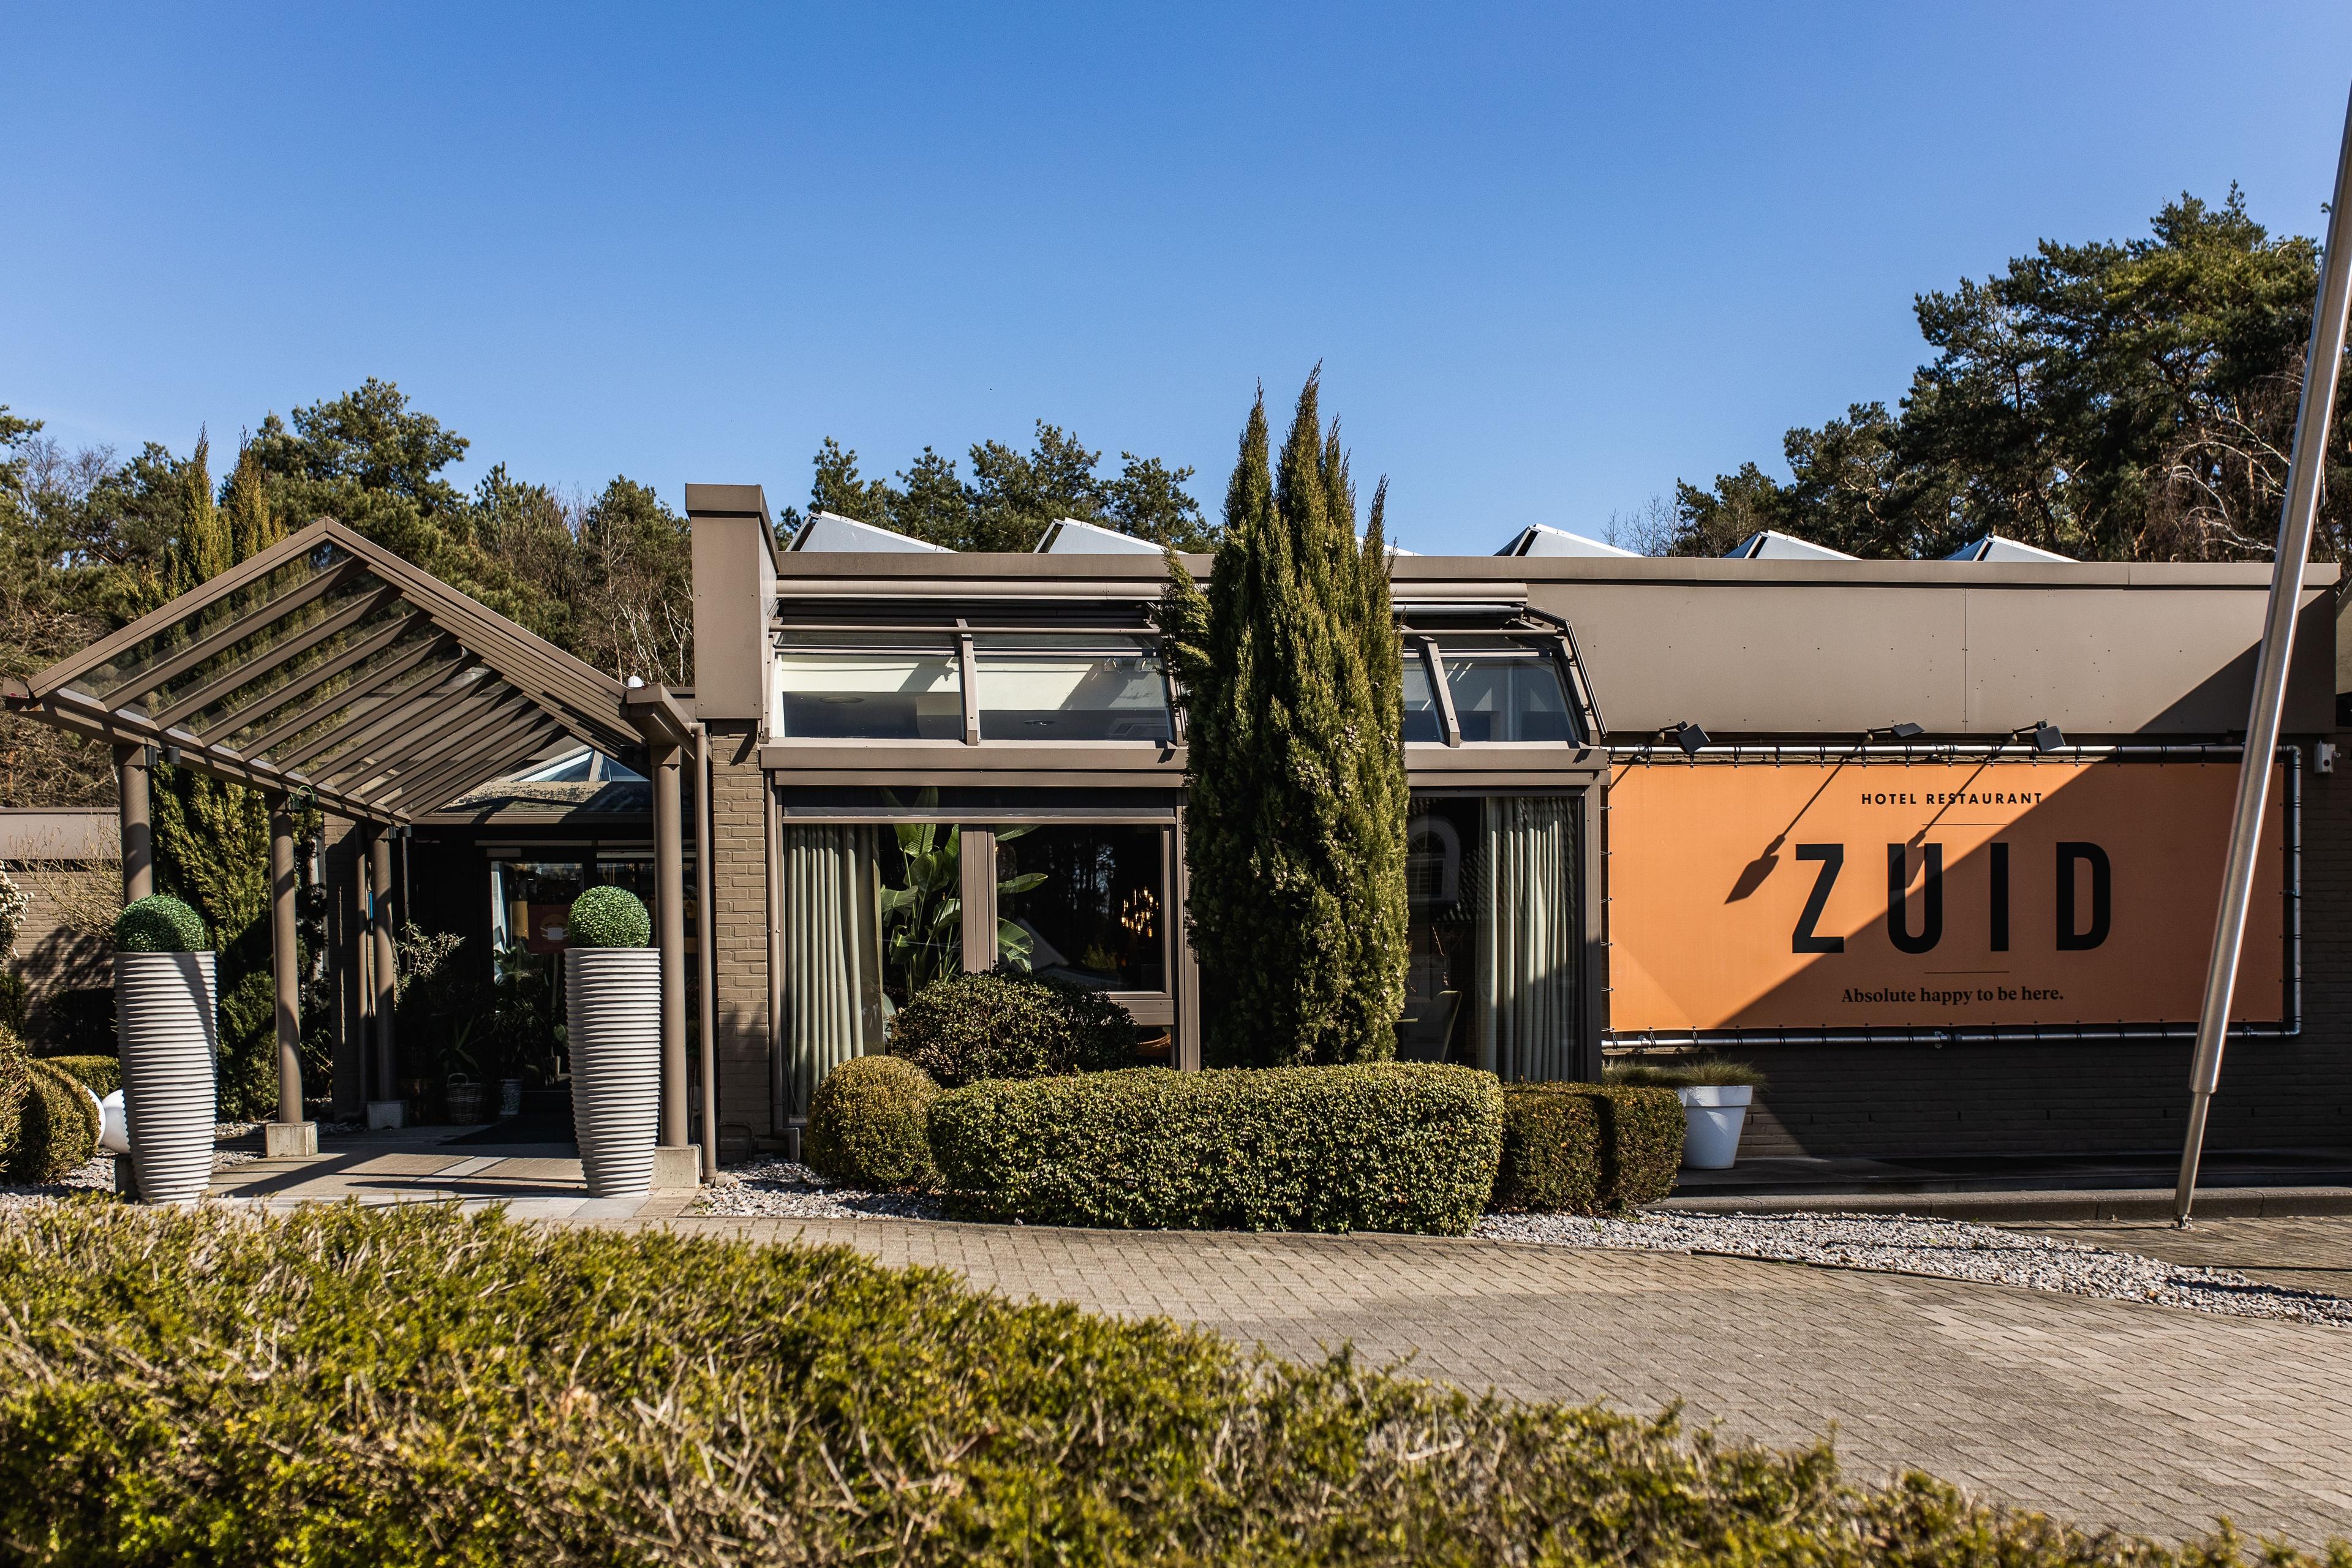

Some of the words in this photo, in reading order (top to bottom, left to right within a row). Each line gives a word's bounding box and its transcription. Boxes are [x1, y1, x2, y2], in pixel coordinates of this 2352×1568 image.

[1861, 793, 1917, 804] HOTEL
[1926, 793, 2042, 804] RESTAURANT
[1792, 842, 2111, 954] ZUID
[1841, 988, 1916, 1003] Absolute
[1920, 987, 1973, 1005] happy
[1977, 989, 1994, 1001] to
[1997, 987, 2018, 1001] be
[2021, 986, 2064, 1000] here.
